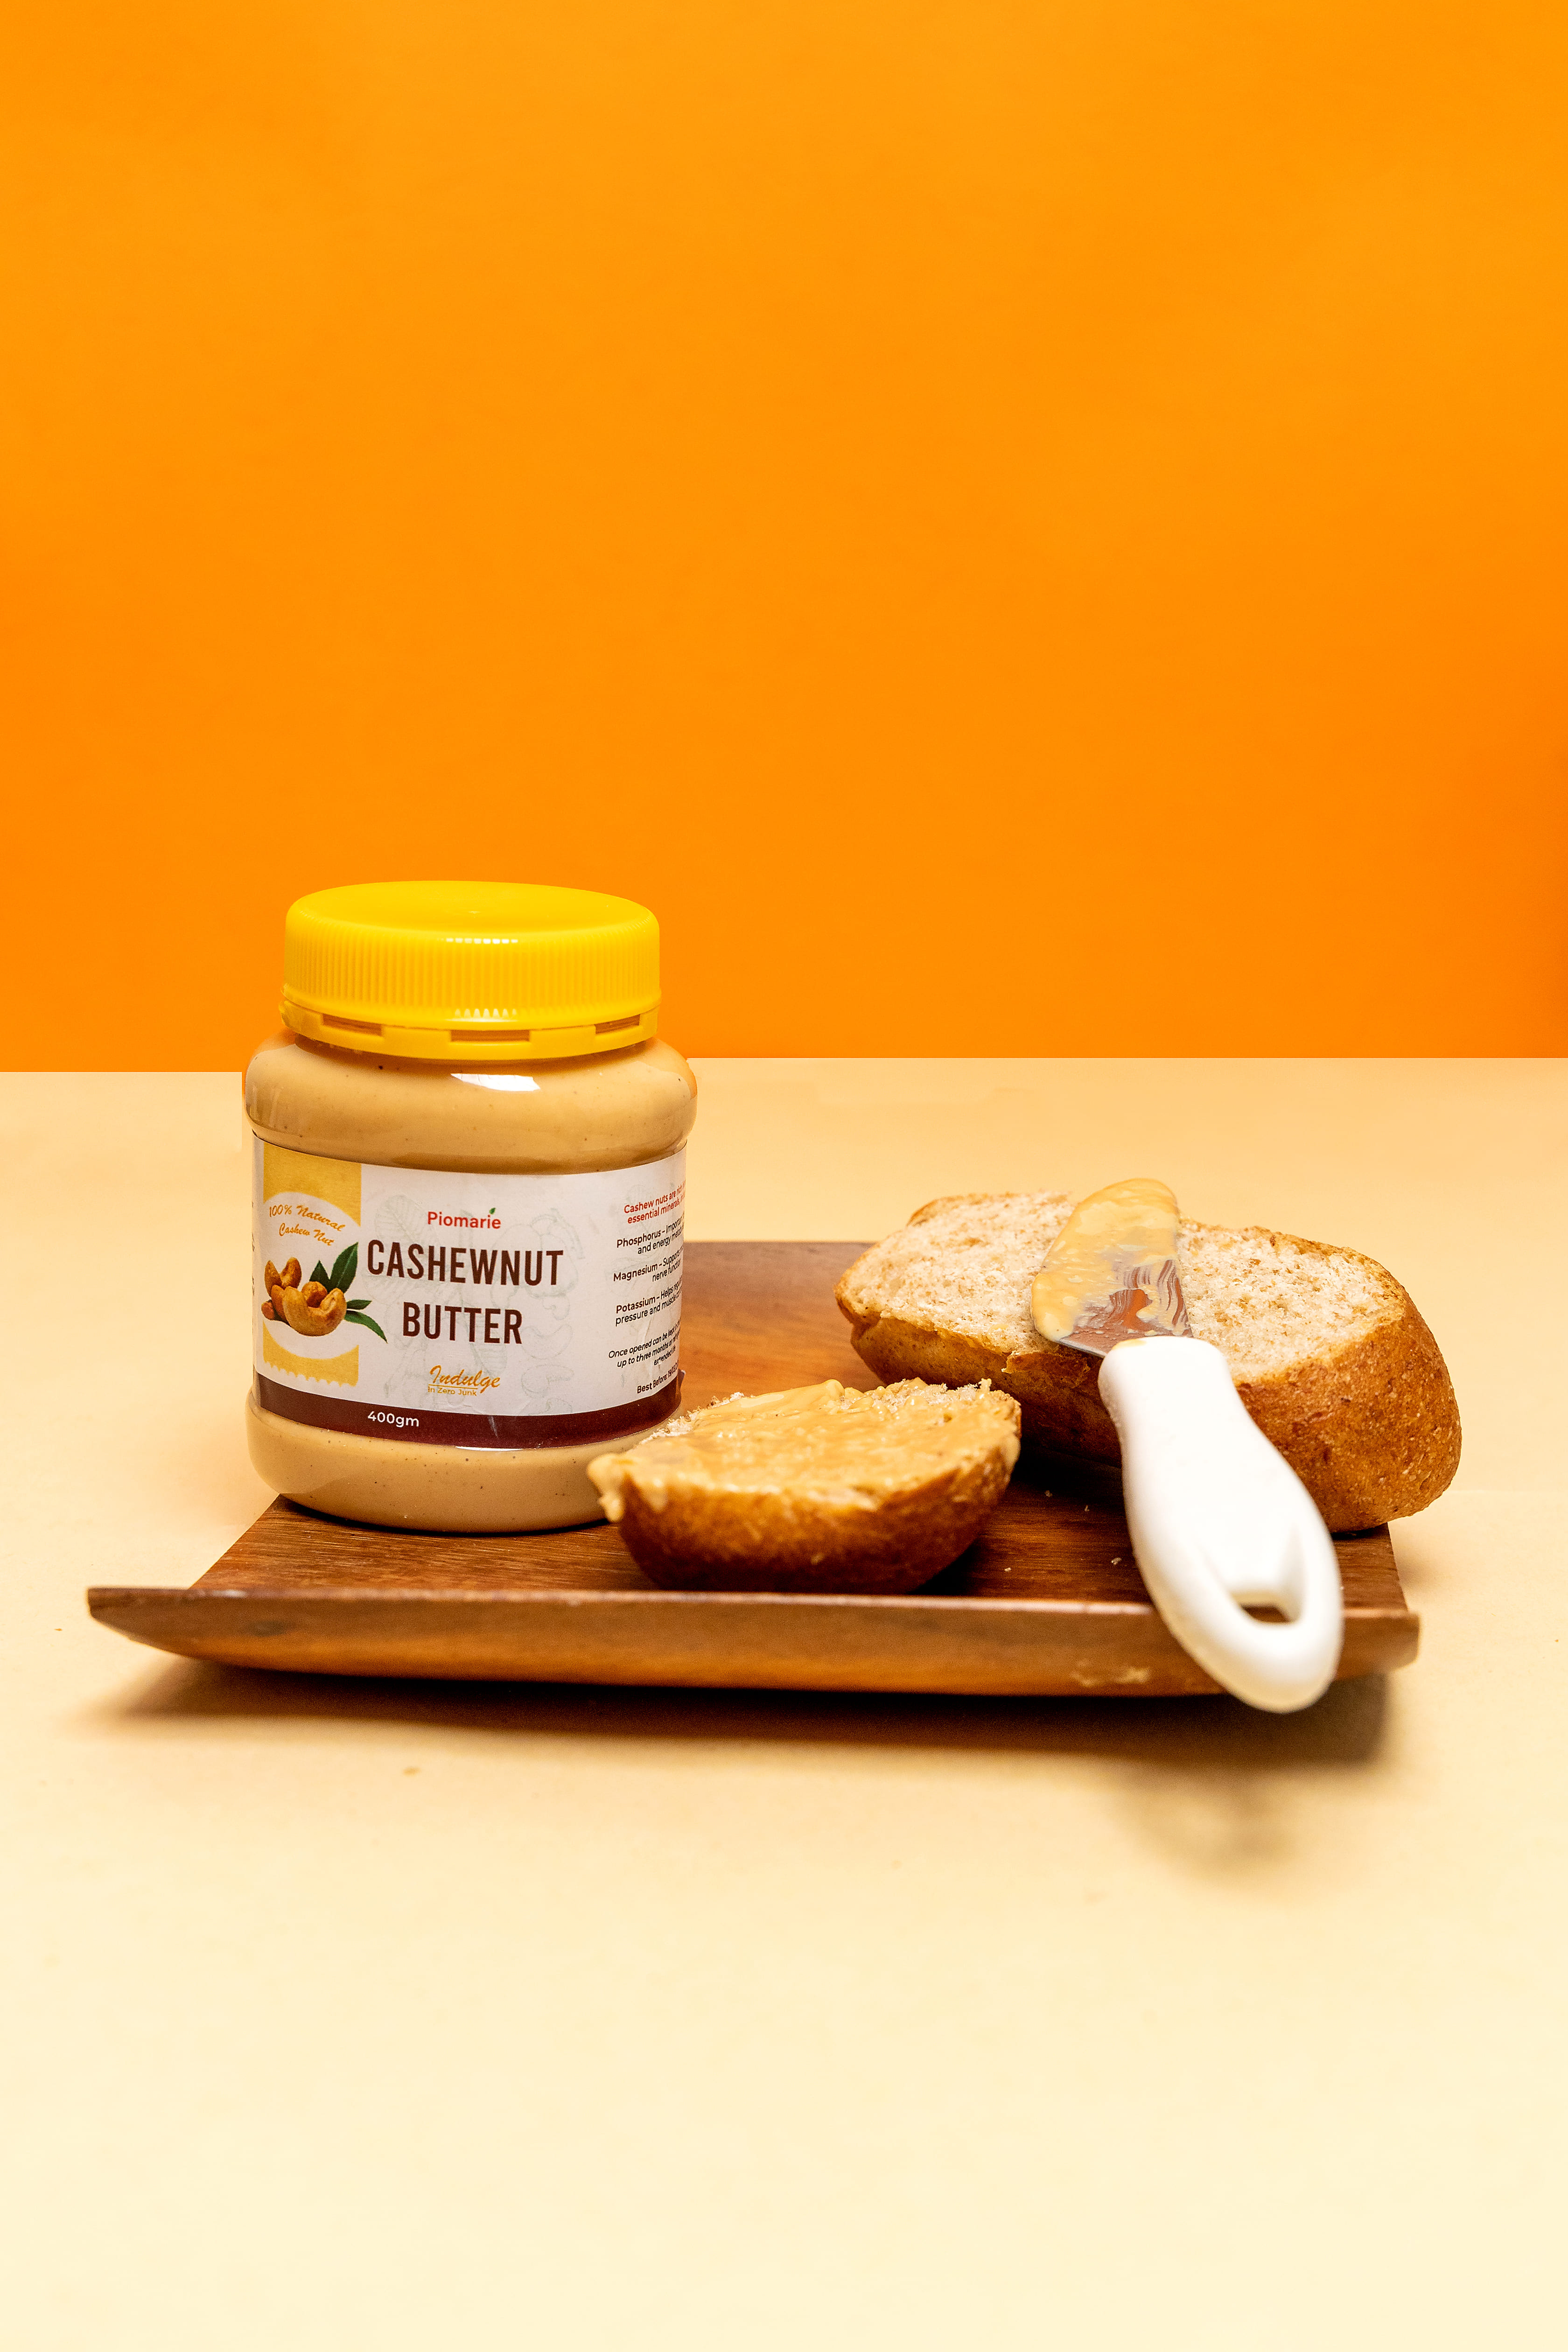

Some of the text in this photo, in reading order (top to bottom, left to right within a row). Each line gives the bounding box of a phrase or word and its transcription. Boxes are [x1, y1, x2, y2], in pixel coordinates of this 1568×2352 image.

[624, 1200, 654, 1213] Cashew
[655, 1194, 668, 1206] nuts
[269, 1204, 346, 1232] 100% Natural
[427, 1211, 501, 1229] Piomarie
[628, 1207, 659, 1224] essential
[279, 1223, 335, 1246] Cashew Nut
[617, 1230, 661, 1248] Phosphorus
[637, 1242, 651, 1254] and
[653, 1235, 672, 1249] energy
[367, 1239, 564, 1286] CASHEWNUT
[613, 1264, 658, 1281] Magnesium
[663, 1249, 680, 1267] Supports
[652, 1269, 667, 1282] nerve
[616, 1296, 656, 1314] Potassium
[661, 1286, 673, 1300] Helps
[616, 1293, 676, 1327] pressure and muscle
[403, 1302, 523, 1344] BUTTER
[609, 1349, 628, 1358] Once
[629, 1338, 652, 1355] opened
[652, 1336, 662, 1345] can
[662, 1332, 668, 1341] be
[617, 1359, 627, 1368] up
[628, 1356, 635, 1365] to
[636, 1352, 651, 1362] three
[652, 1342, 669, 1356] months
[654, 1349, 672, 1366] extended
[429, 1365, 501, 1393] Indulge
[637, 1382, 652, 1394] Best
[653, 1373, 668, 1388] Before:
[367, 1411, 419, 1428] 400gm
